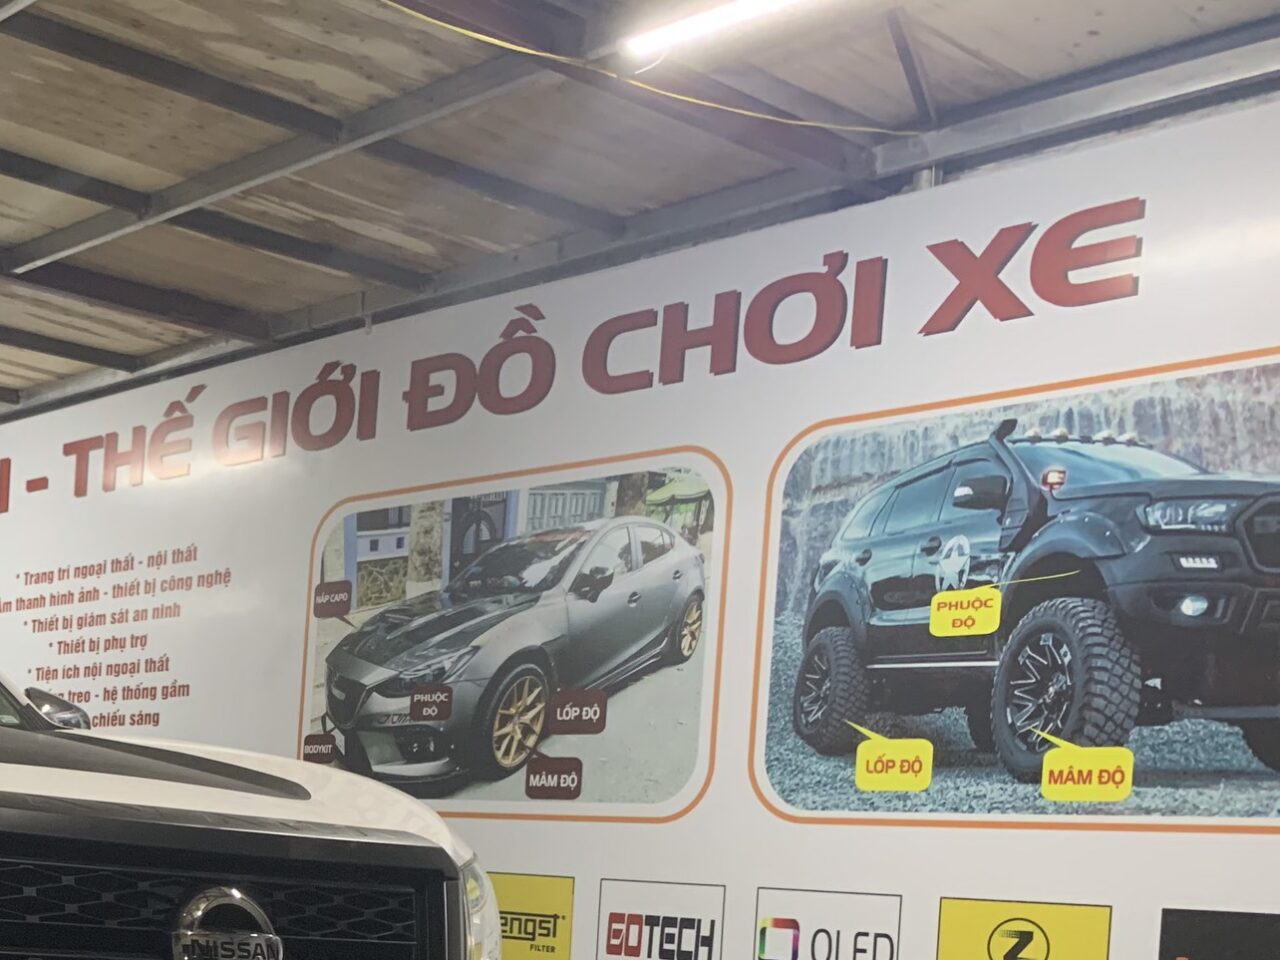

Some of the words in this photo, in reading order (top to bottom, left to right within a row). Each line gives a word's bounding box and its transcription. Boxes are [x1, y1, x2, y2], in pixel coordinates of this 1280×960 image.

[62, 384, 208, 498] THẾ
[211, 361, 380, 467] GIỚI
[403, 303, 555, 431] ĐỒ
[581, 250, 888, 395] CHƠI
[918, 197, 1147, 336] XE
[24, 570, 54, 586] Trang
[74, 559, 107, 579] ngoại
[111, 552, 135, 574] thất
[171, 543, 198, 565] thất
[15, 594, 46, 612] thanh
[937, 597, 994, 612] PHUỘC
[31, 614, 59, 633] Thiết
[133, 607, 148, 622] an
[152, 602, 182, 620] ninh
[952, 615, 976, 630] ĐỘ
[57, 636, 85, 655] Thiết
[106, 659, 140, 679] ngoại
[144, 653, 170, 673] thất
[67, 688, 91, 704] treo
[103, 686, 118, 704] hệ
[122, 682, 157, 701] thống
[556, 702, 580, 721] LỐP
[582, 703, 601, 722] ĐỘ
[866, 753, 896, 775] LỐP
[899, 755, 923, 776] ĐỘ
[1048, 766, 1093, 786] MÂM
[1097, 766, 1126, 789] ĐỘ
[499, 910, 560, 941] engst
[190, 938, 279, 960] NISSAN
[529, 944, 556, 953] FILTER
